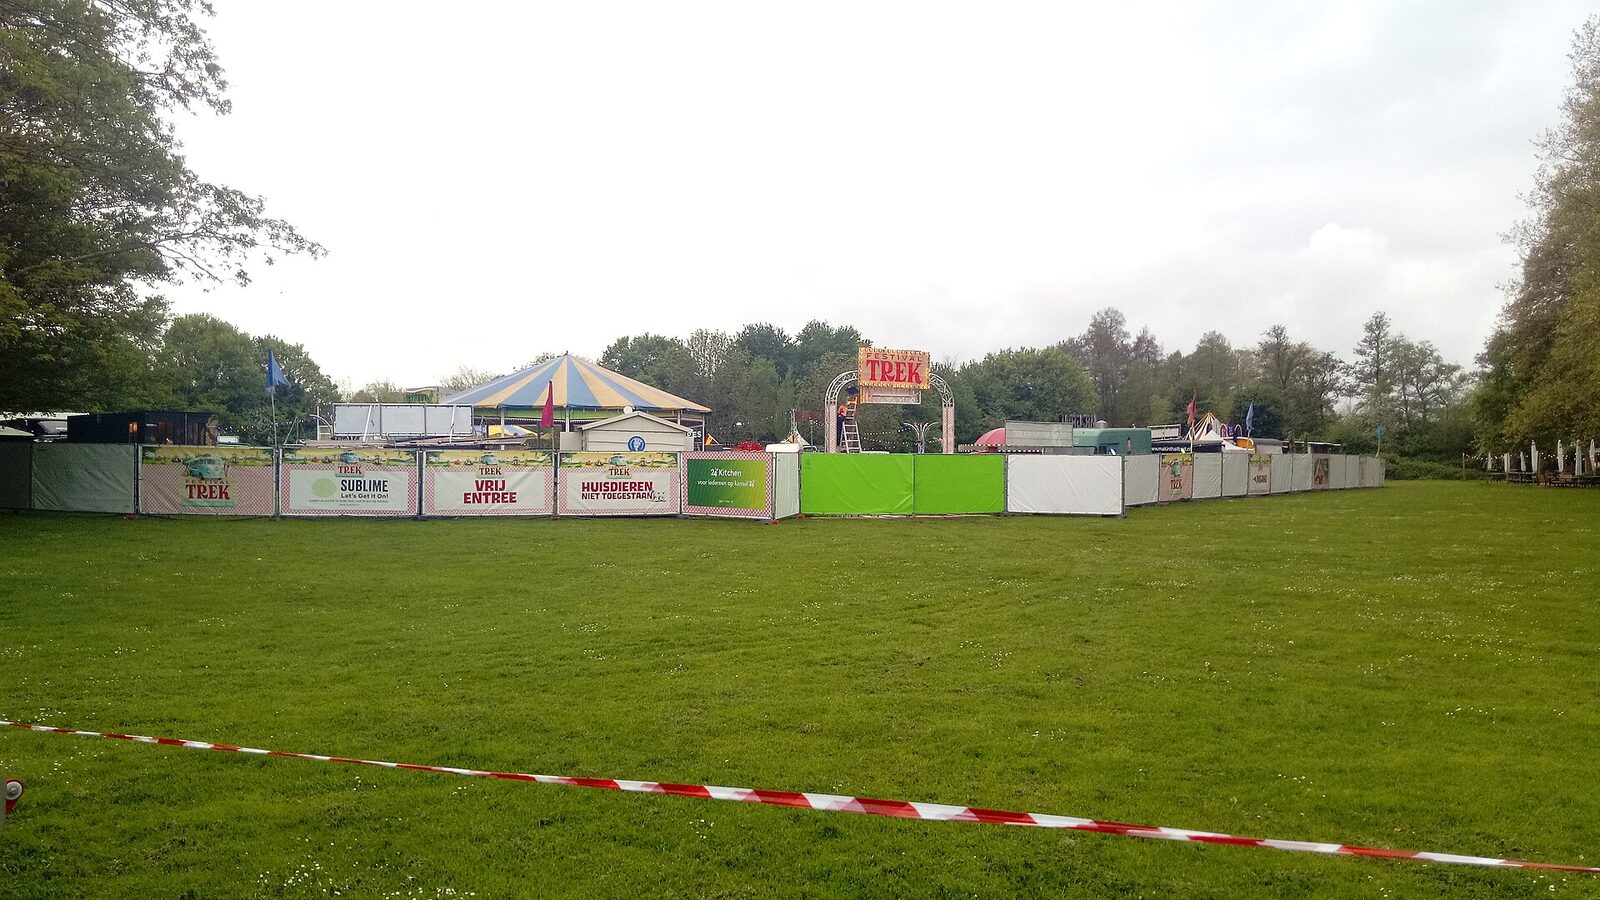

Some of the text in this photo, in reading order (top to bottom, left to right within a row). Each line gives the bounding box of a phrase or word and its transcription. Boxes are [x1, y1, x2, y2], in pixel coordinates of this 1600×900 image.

[866, 353, 922, 362] FESTIVAL
[866, 360, 922, 384] TREK
[338, 466, 362, 474] TREK
[340, 480, 389, 492] SUBLIME
[475, 480, 506, 491] VRIJ
[581, 482, 653, 492] HUISDIEREN
[186, 485, 230, 500] TREK
[463, 492, 517, 504] ENTREE
